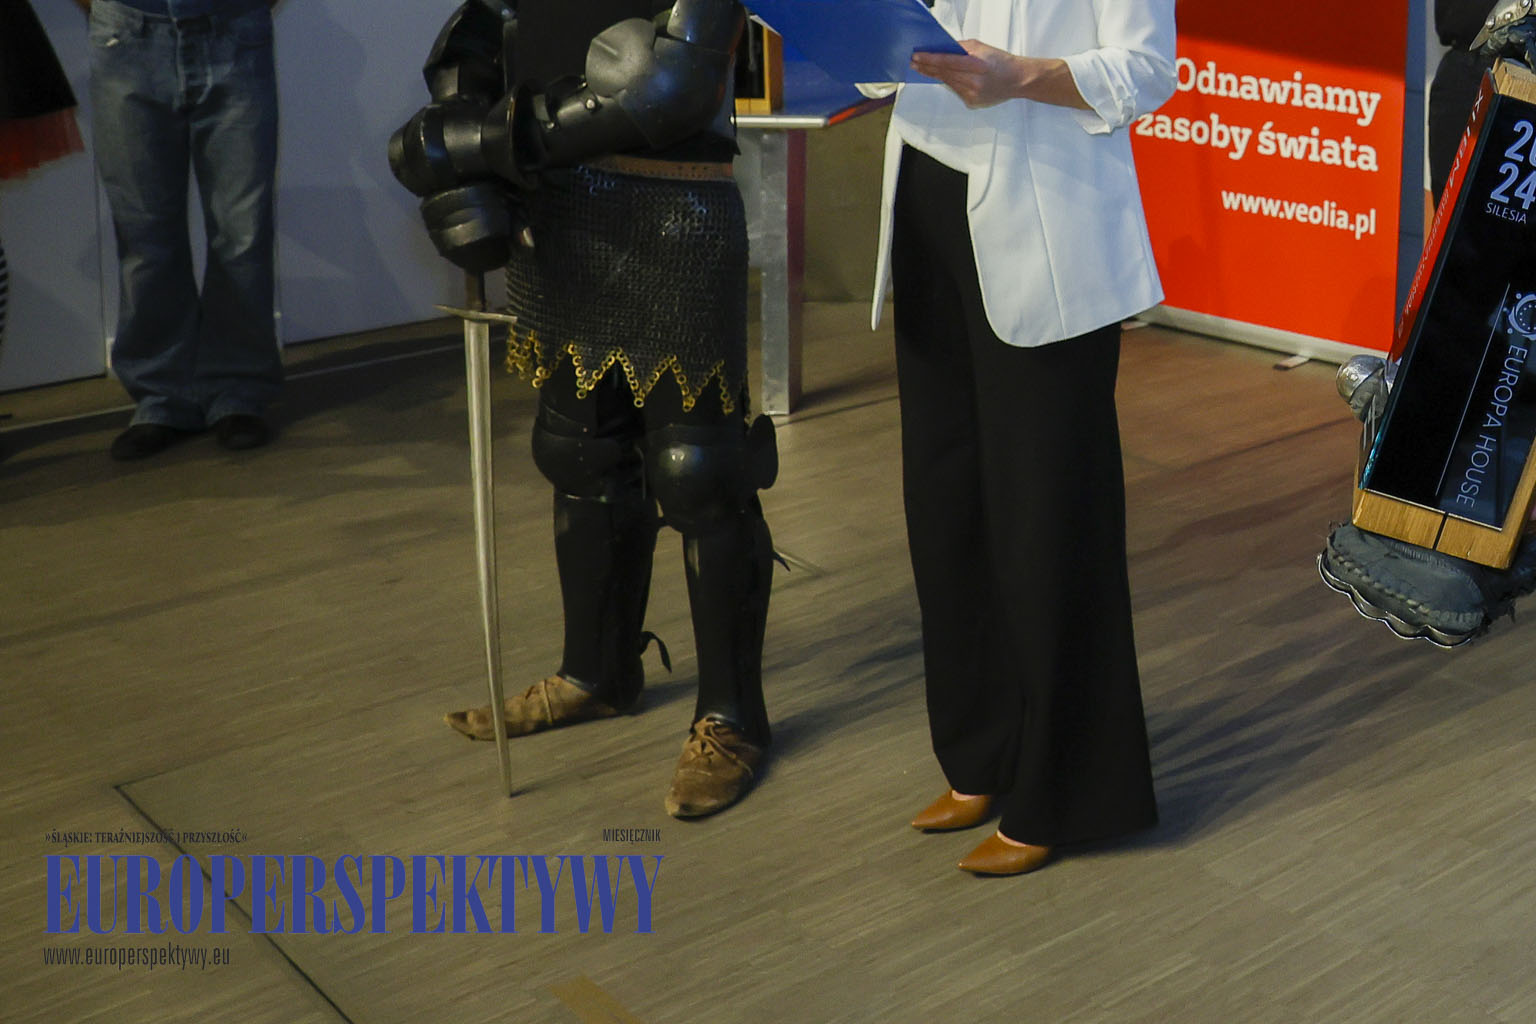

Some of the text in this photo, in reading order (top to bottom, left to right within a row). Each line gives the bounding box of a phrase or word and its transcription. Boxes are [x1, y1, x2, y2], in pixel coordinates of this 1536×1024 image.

[1175, 57, 1381, 127] Odnawiamy
[1135, 112, 1378, 172] zasoby świata
[1221, 189, 1376, 240] www.veolia.pl
[1485, 202, 1528, 224] SILESIA
[1456, 345, 1527, 509] EUROPA HOUSE
